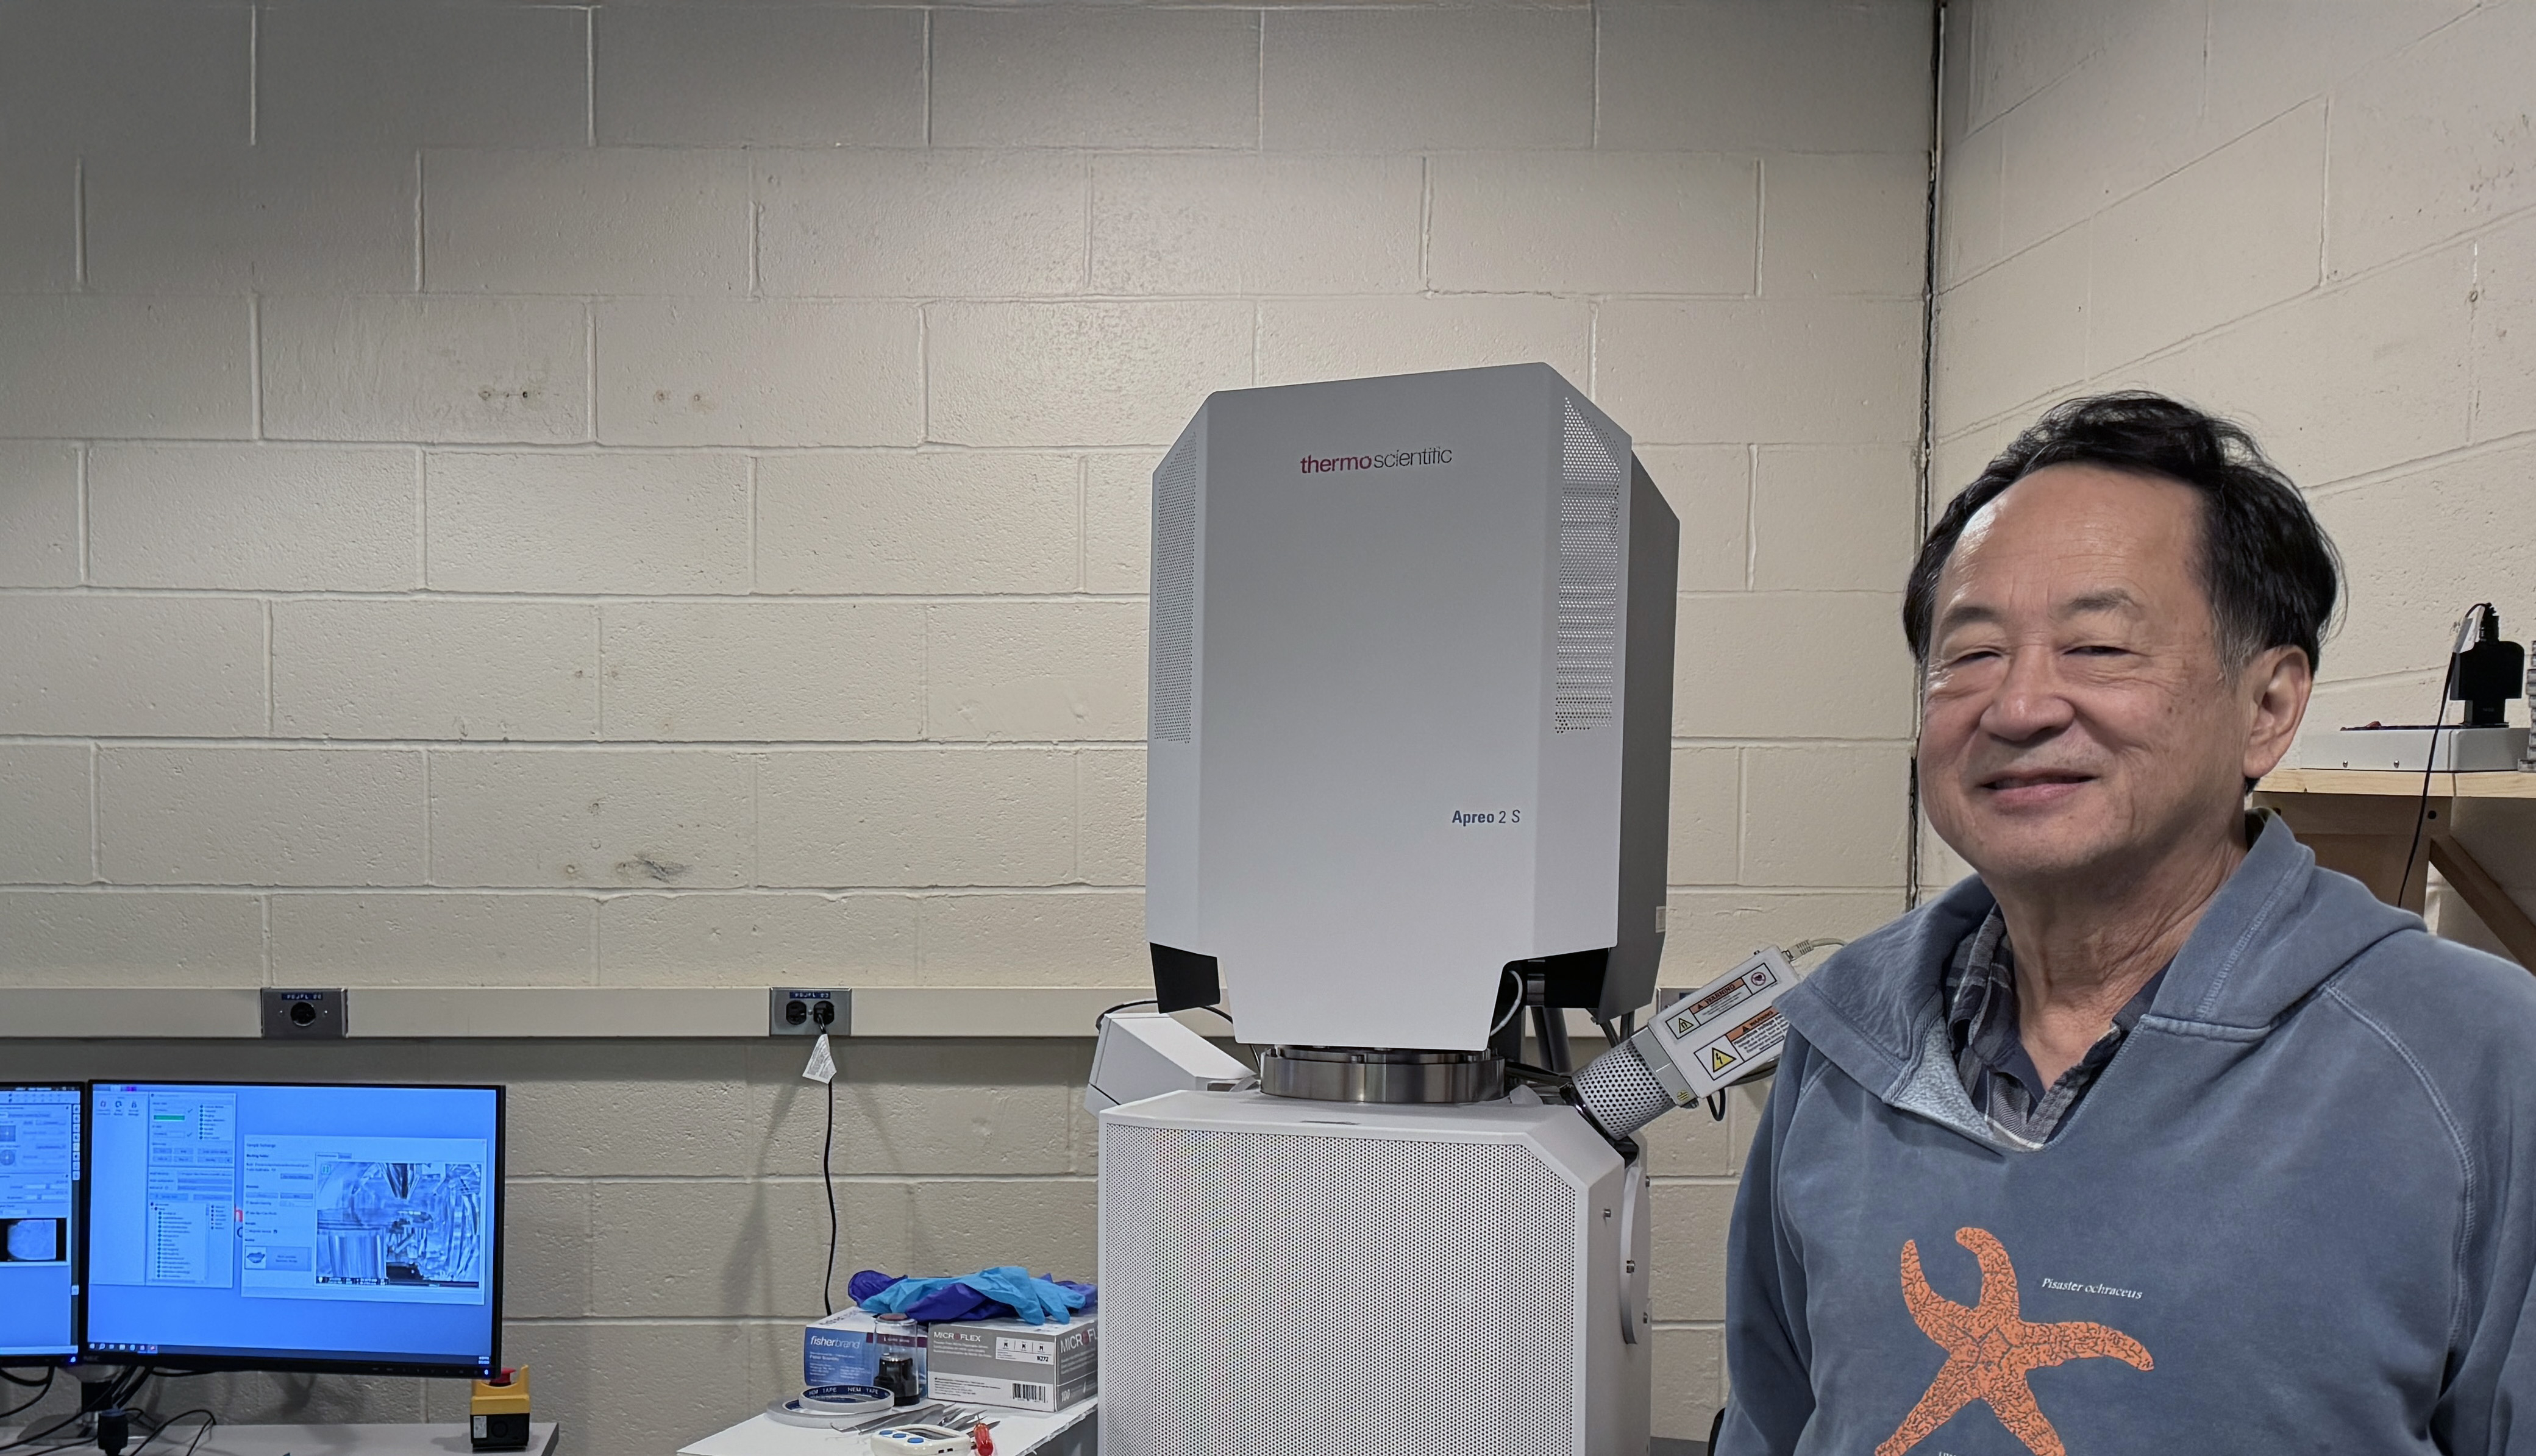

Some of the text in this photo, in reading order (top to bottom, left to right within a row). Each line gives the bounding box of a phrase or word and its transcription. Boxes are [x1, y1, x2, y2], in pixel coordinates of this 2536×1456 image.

[1300, 446, 1452, 474] thermo scientific
[1452, 809, 1520, 826] Apreo 2 S
[1705, 984, 1736, 1004] WARNING
[2042, 1278, 2143, 1299] Pisaster ochraceus
[810, 1335, 861, 1349] fisherbrand
[934, 1332, 981, 1342] MICROFLEX
[1061, 1329, 1097, 1353] MICROFL
